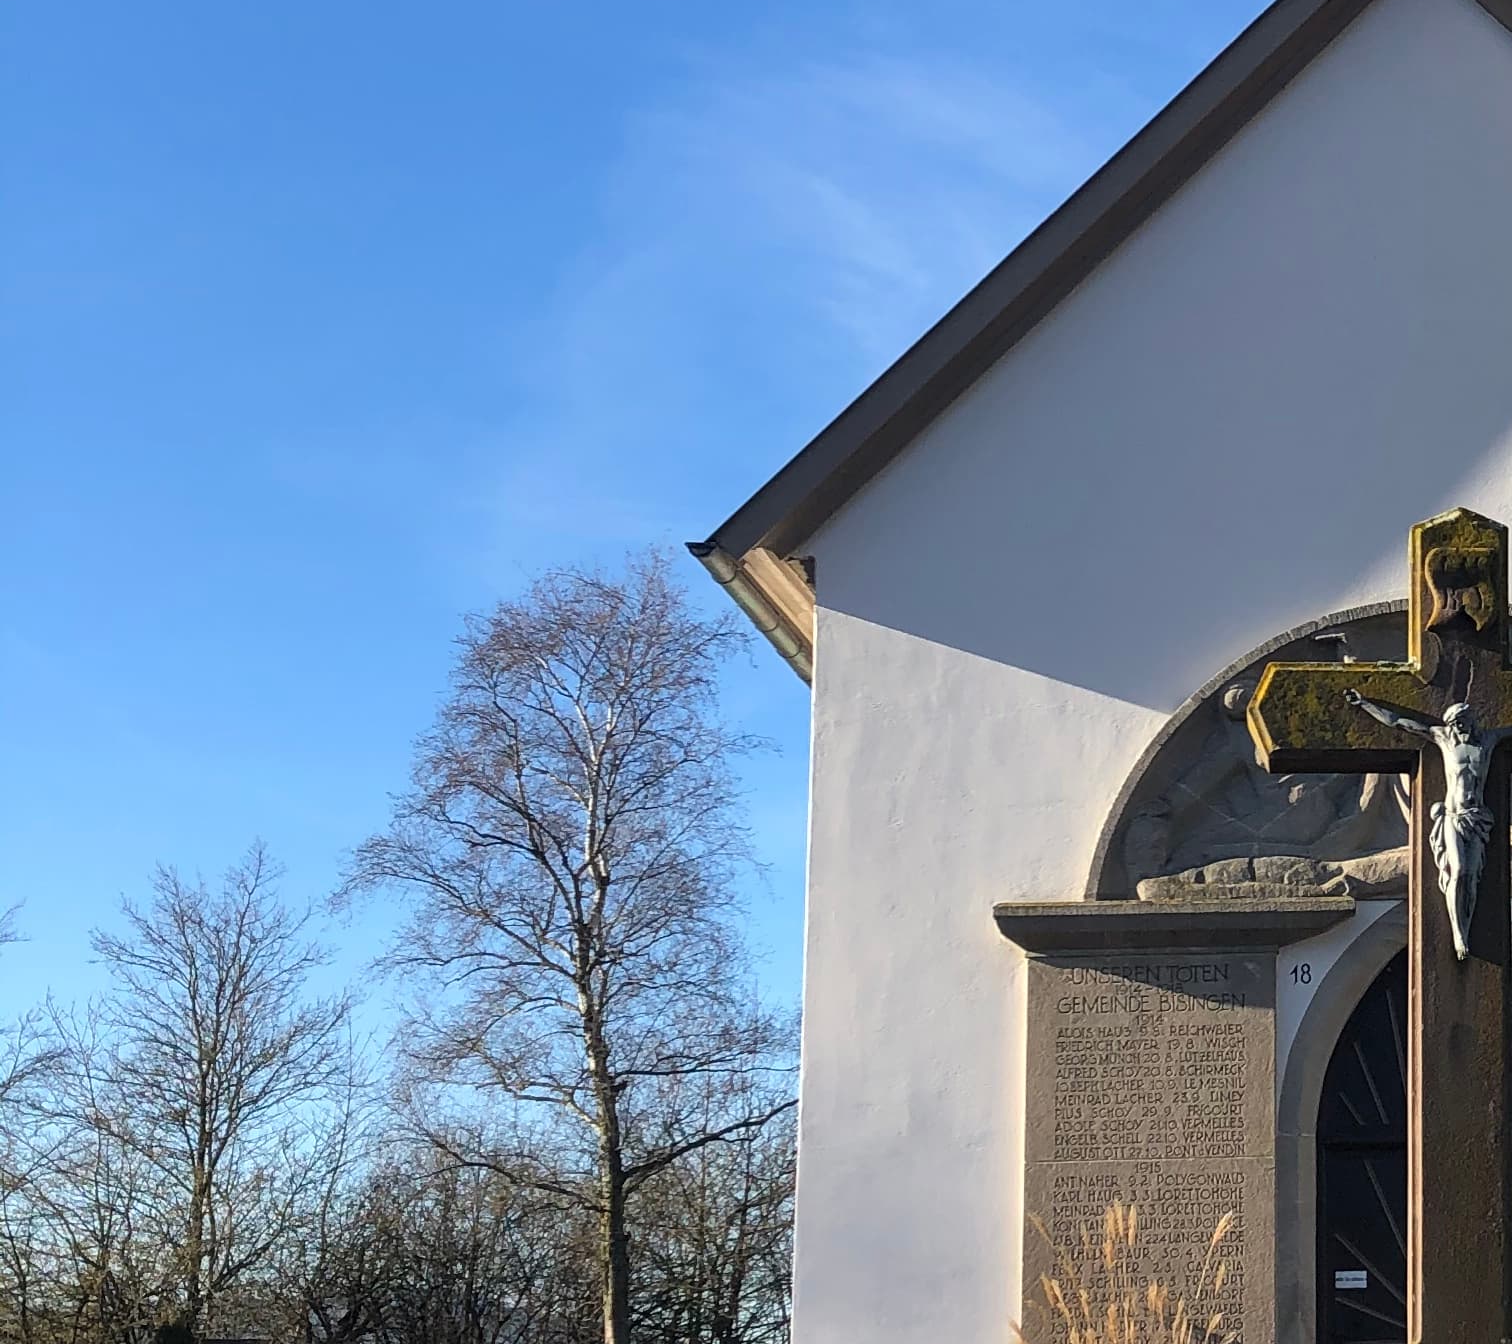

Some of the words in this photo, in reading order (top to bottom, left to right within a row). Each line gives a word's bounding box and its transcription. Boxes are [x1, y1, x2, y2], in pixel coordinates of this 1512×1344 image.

[1167, 964, 1228, 982] TOTEN
[1289, 963, 1312, 985] 18
[1056, 995, 1151, 1014] GEMEINDE
[1159, 993, 1245, 1013] BISINGEN
[1056, 1040, 1113, 1053] FRIEDRICH
[1056, 1067, 1097, 1079] ALFRED
[1101, 1066, 1142, 1078] SCHOY
[1115, 1093, 1163, 1104] LACHER
[1055, 1108, 1081, 1119] PIUS
[1092, 1107, 1132, 1118] SCHOY
[1100, 1119, 1144, 1132] SCHOY
[1182, 1118, 1244, 1130] VERMELLES
[1102, 1133, 1143, 1145] SCHELL
[1183, 1131, 1244, 1143] VERMELLES
